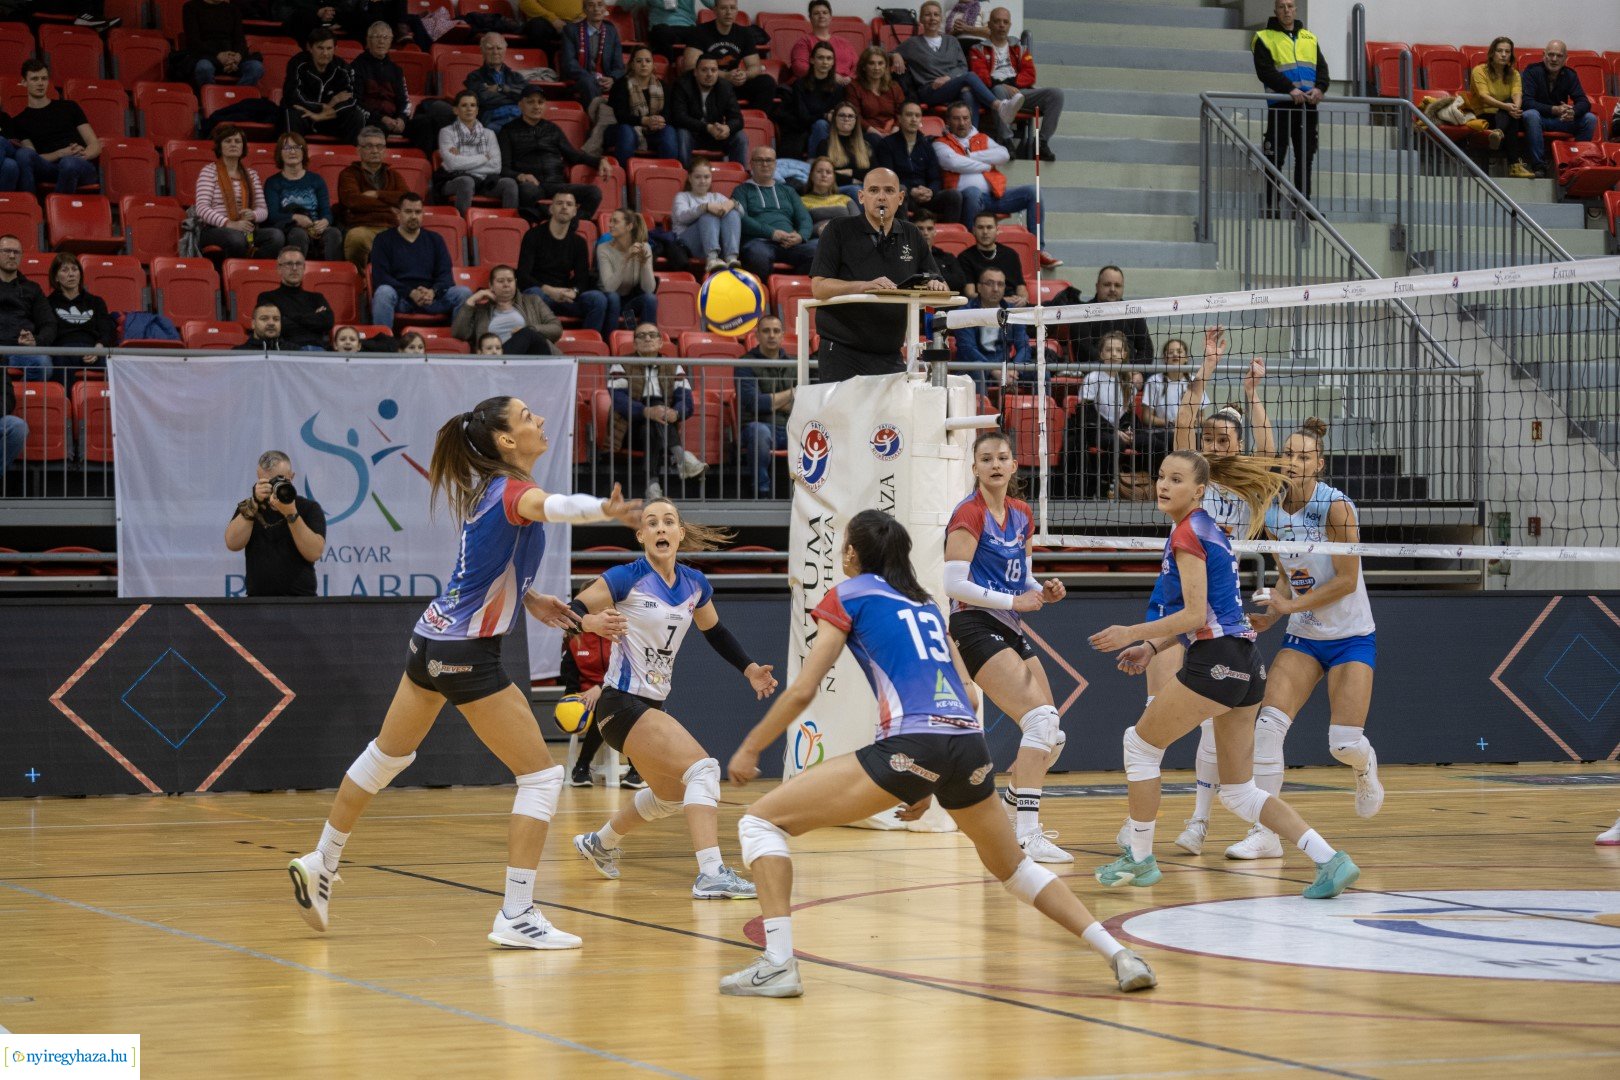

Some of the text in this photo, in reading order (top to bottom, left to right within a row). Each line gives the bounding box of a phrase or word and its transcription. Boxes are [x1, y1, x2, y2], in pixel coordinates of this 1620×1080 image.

[1553, 266, 1576, 279] FATUM
[318, 546, 392, 563] AGYAR
[1005, 558, 1021, 582] 18
[667, 625, 677, 649] 7
[897, 608, 951, 663] 13
